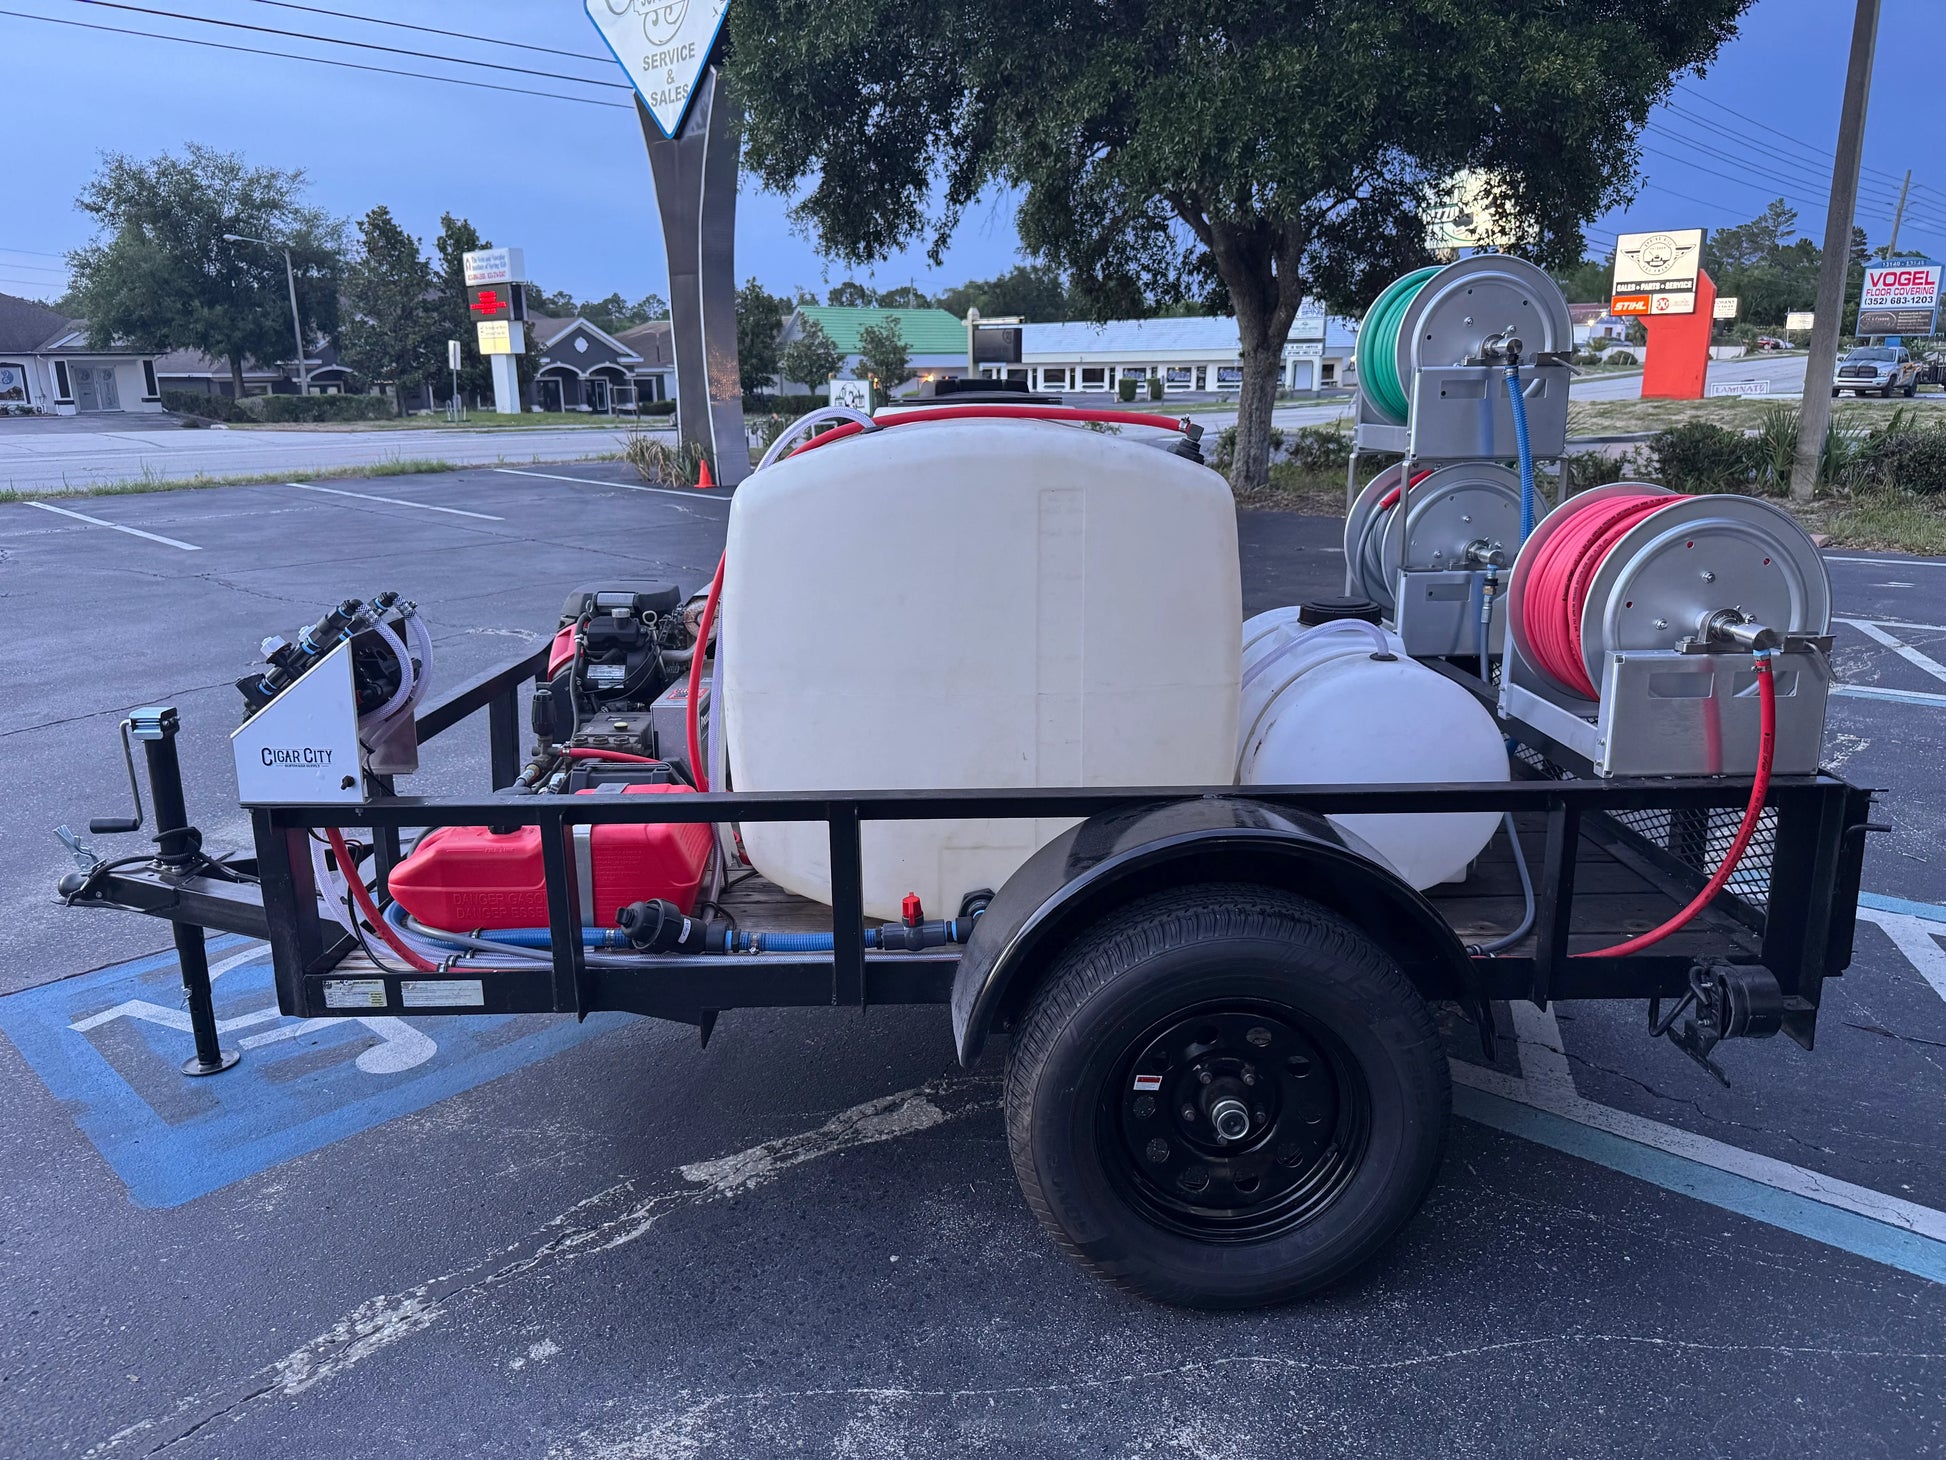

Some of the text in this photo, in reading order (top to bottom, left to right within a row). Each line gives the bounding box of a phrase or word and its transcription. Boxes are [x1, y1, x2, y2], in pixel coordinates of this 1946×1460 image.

[643, 42, 695, 71] SERVICE
[666, 69, 675, 84] &
[650, 84, 689, 107] SALES
[1870, 271, 1936, 288] VOGEL
[1616, 280, 1692, 292] SALES PARTS SERVICE
[1866, 287, 1934, 296] FLOOR COVERING
[1614, 300, 1646, 310] STIHL
[1890, 296, 1934, 304] 683-1203
[453, 893, 504, 905] DANGER
[456, 907, 506, 919] DANGER
